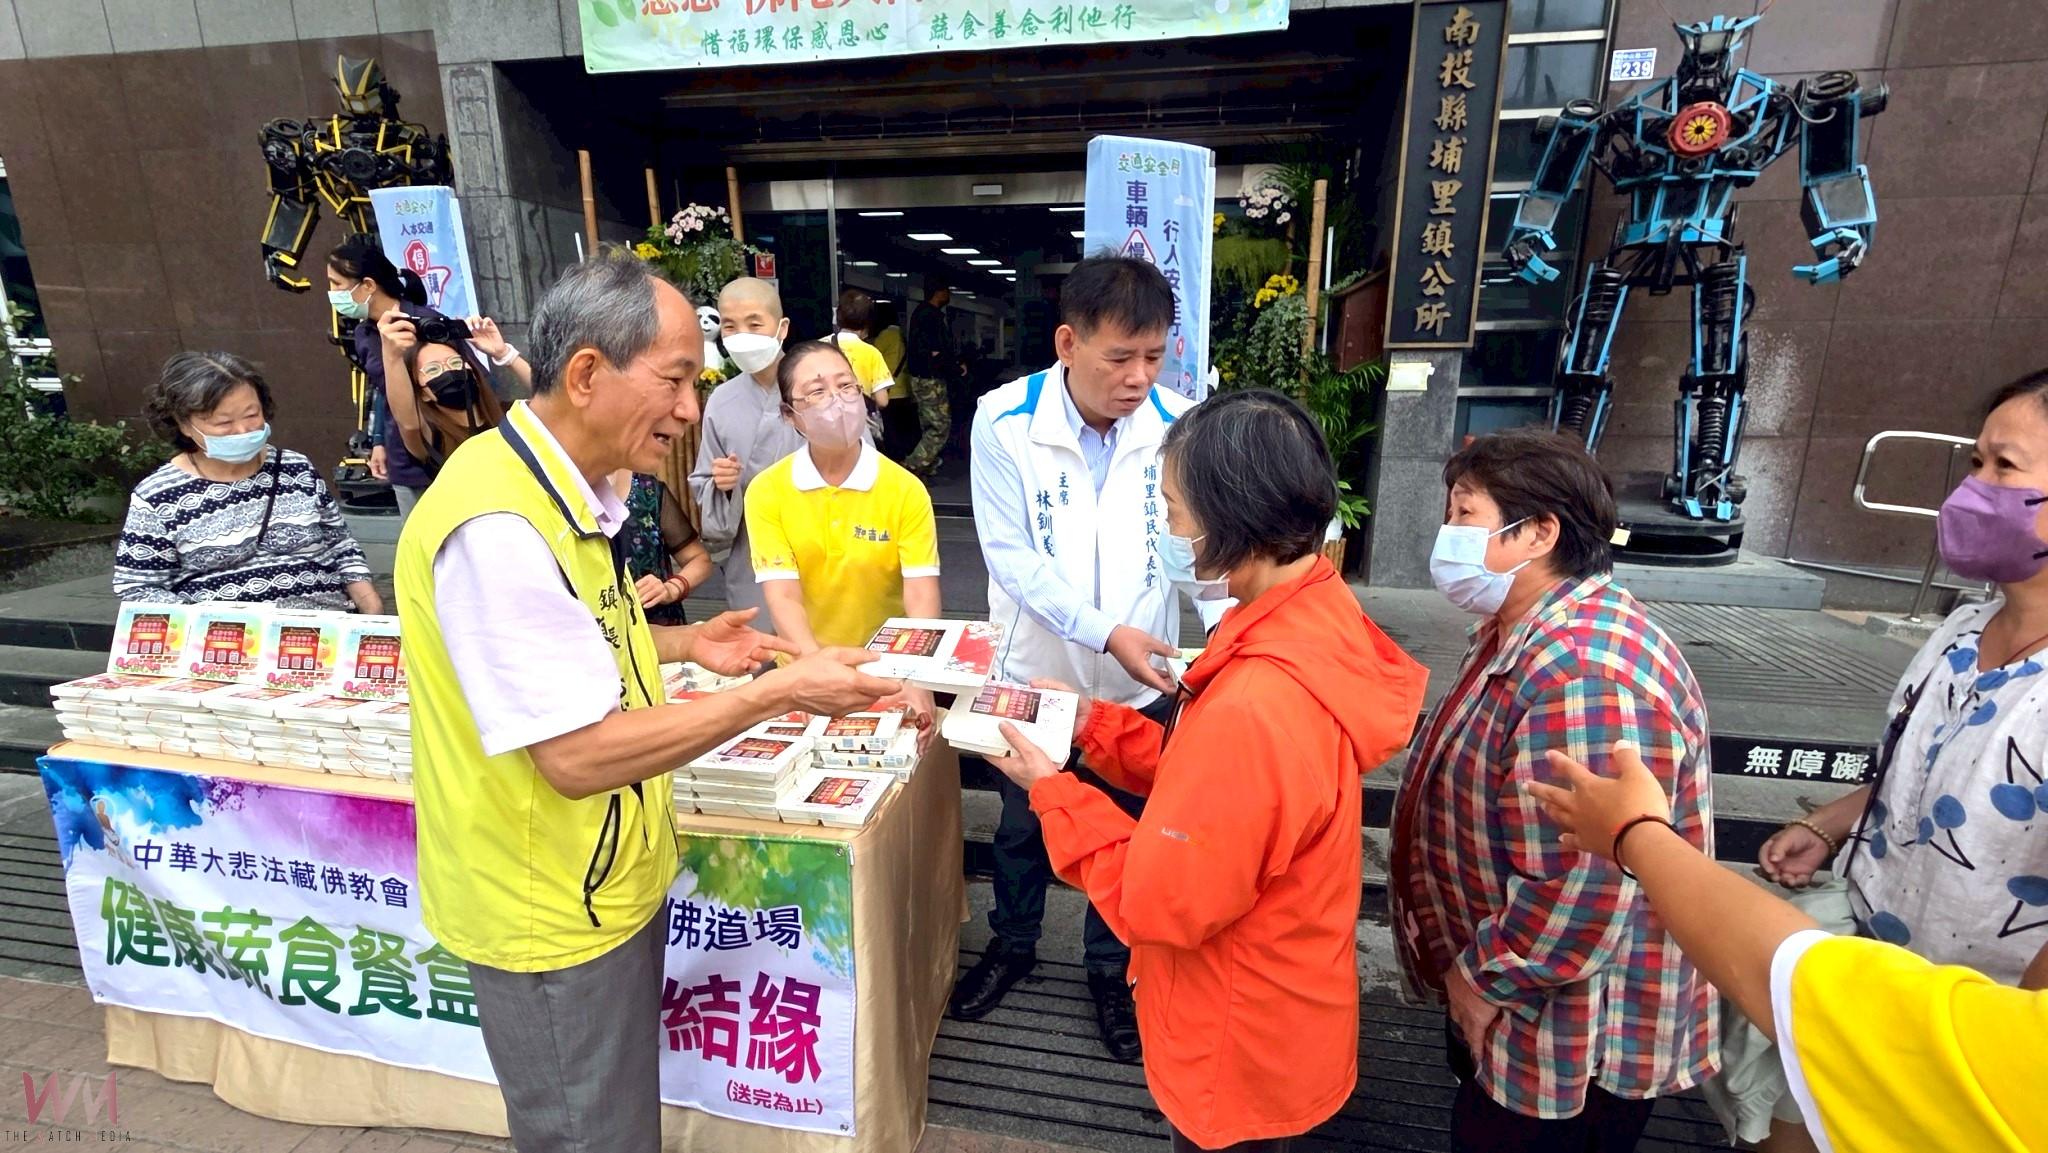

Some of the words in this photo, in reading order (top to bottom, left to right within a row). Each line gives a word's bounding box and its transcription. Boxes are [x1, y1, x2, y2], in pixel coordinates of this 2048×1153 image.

[701, 19, 889, 57] 惜福環保感恩心
[929, 4, 1137, 42] 蔬食善念利他行
[1621, 61, 1651, 77] 239
[1118, 152, 1180, 176] 交通安全月
[1414, 7, 1481, 337] 南投縣埔里鎮公所
[401, 222, 434, 236] 人本交通
[412, 248, 424, 271] 停
[1059, 472, 1069, 505] 主席
[1144, 465, 1160, 587] 埔里鎮民代表會
[1744, 746, 1877, 781] 無障礙
[133, 839, 408, 909] 中華大悲法藏佛教會
[666, 897, 802, 952] 佛道場
[101, 876, 480, 1027] 健康蔬食餐盒
[662, 971, 822, 1084] 結緣
[726, 1079, 823, 1116] (送完為止)
